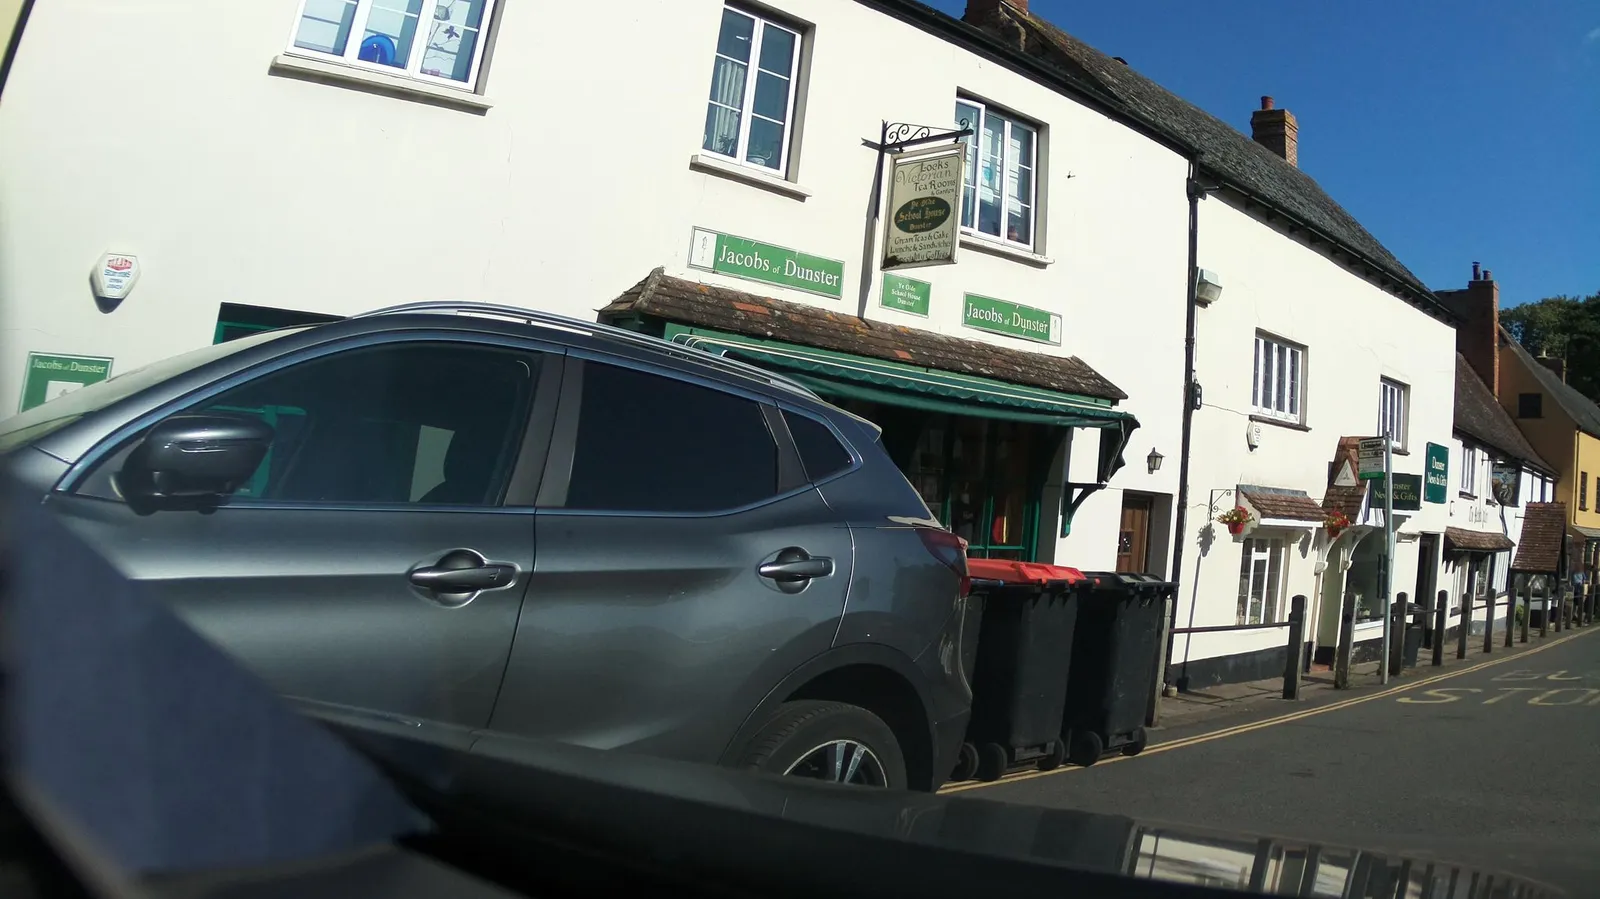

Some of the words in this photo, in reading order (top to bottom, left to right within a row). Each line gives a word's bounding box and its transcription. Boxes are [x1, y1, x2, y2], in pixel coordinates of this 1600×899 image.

[896, 165, 952, 185] Victorian
[914, 182, 927, 192] Tea
[929, 179, 956, 190] Rooms
[897, 210, 922, 222] School
[894, 236, 914, 245] Cream
[719, 245, 770, 271] Jacobs
[772, 266, 781, 274] of
[784, 259, 839, 287] Dunster
[966, 303, 1003, 323] Jacobs
[1012, 312, 1048, 334] Dunster
[32, 359, 62, 370] Jacobs
[70, 361, 106, 373] Dunster
[1382, 480, 1411, 490] Dnster
[1400, 491, 1418, 501] Gifts
